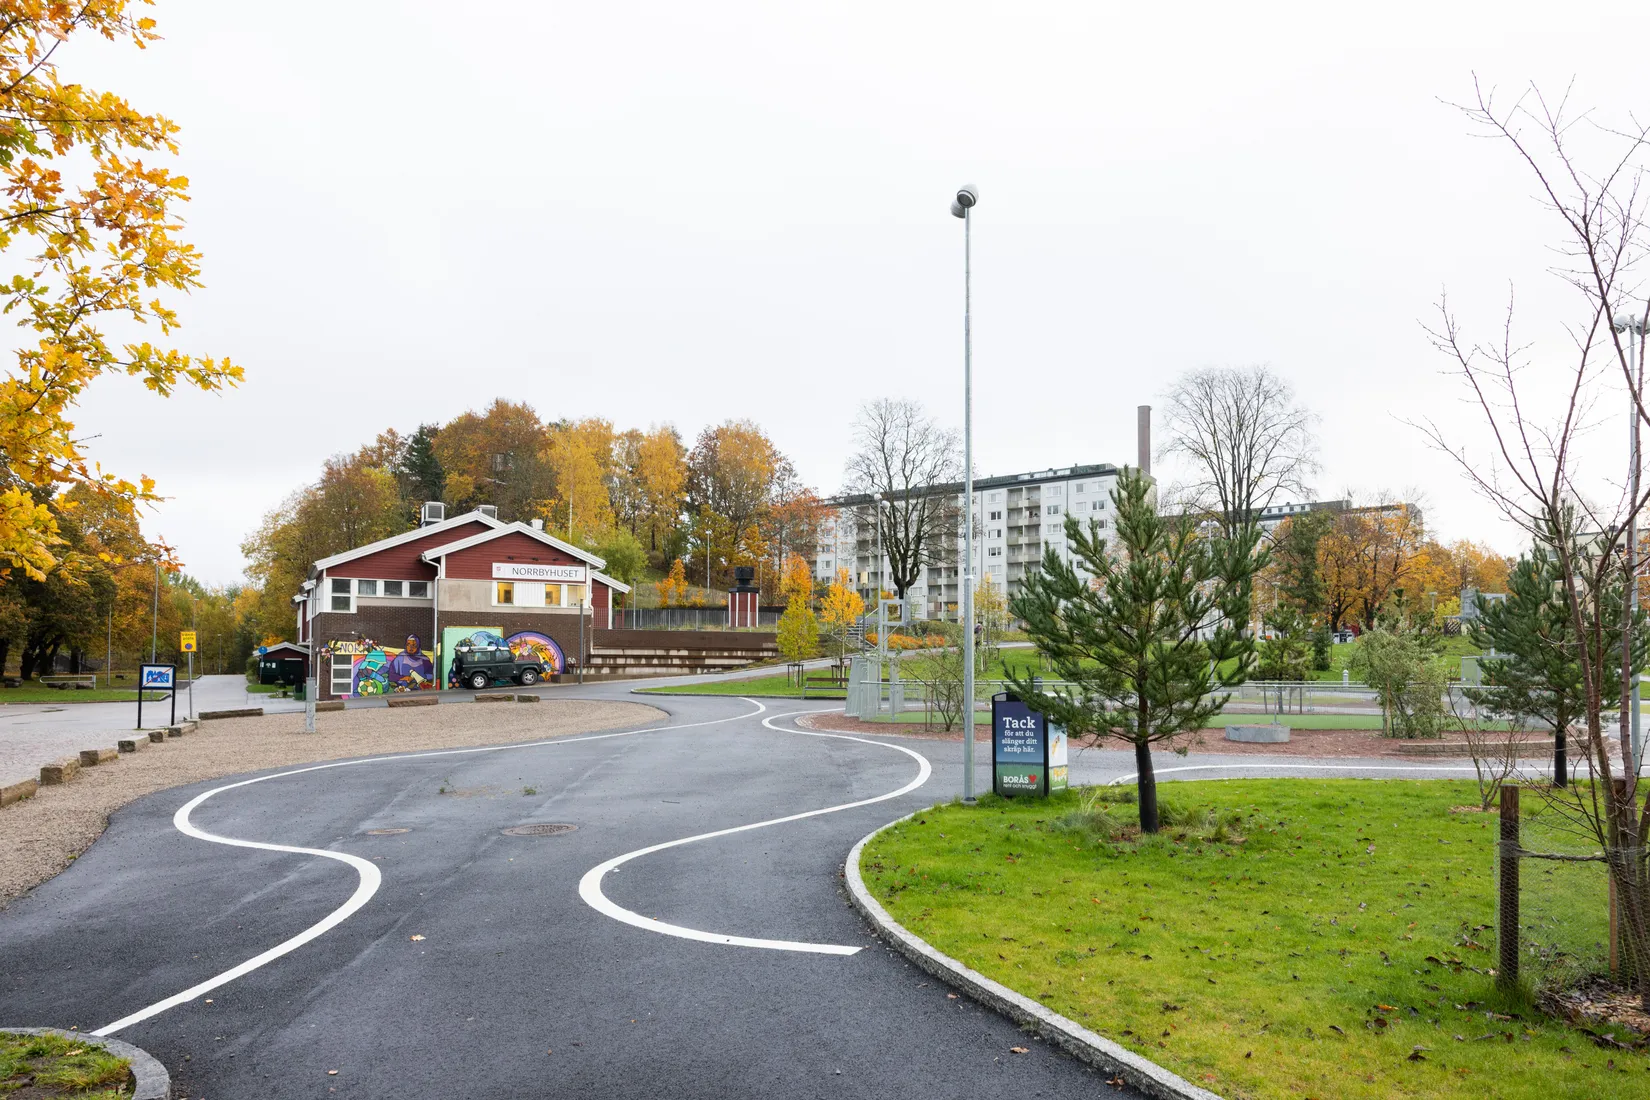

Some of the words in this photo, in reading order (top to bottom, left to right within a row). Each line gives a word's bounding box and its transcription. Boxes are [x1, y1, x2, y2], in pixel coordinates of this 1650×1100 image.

[512, 567, 579, 577] NORRBYHUSET
[1002, 716, 1036, 728] Tack
[1001, 738, 1025, 746] slänger
[1003, 745, 1022, 754] skräp
[1003, 774, 1029, 784] BORÅS
